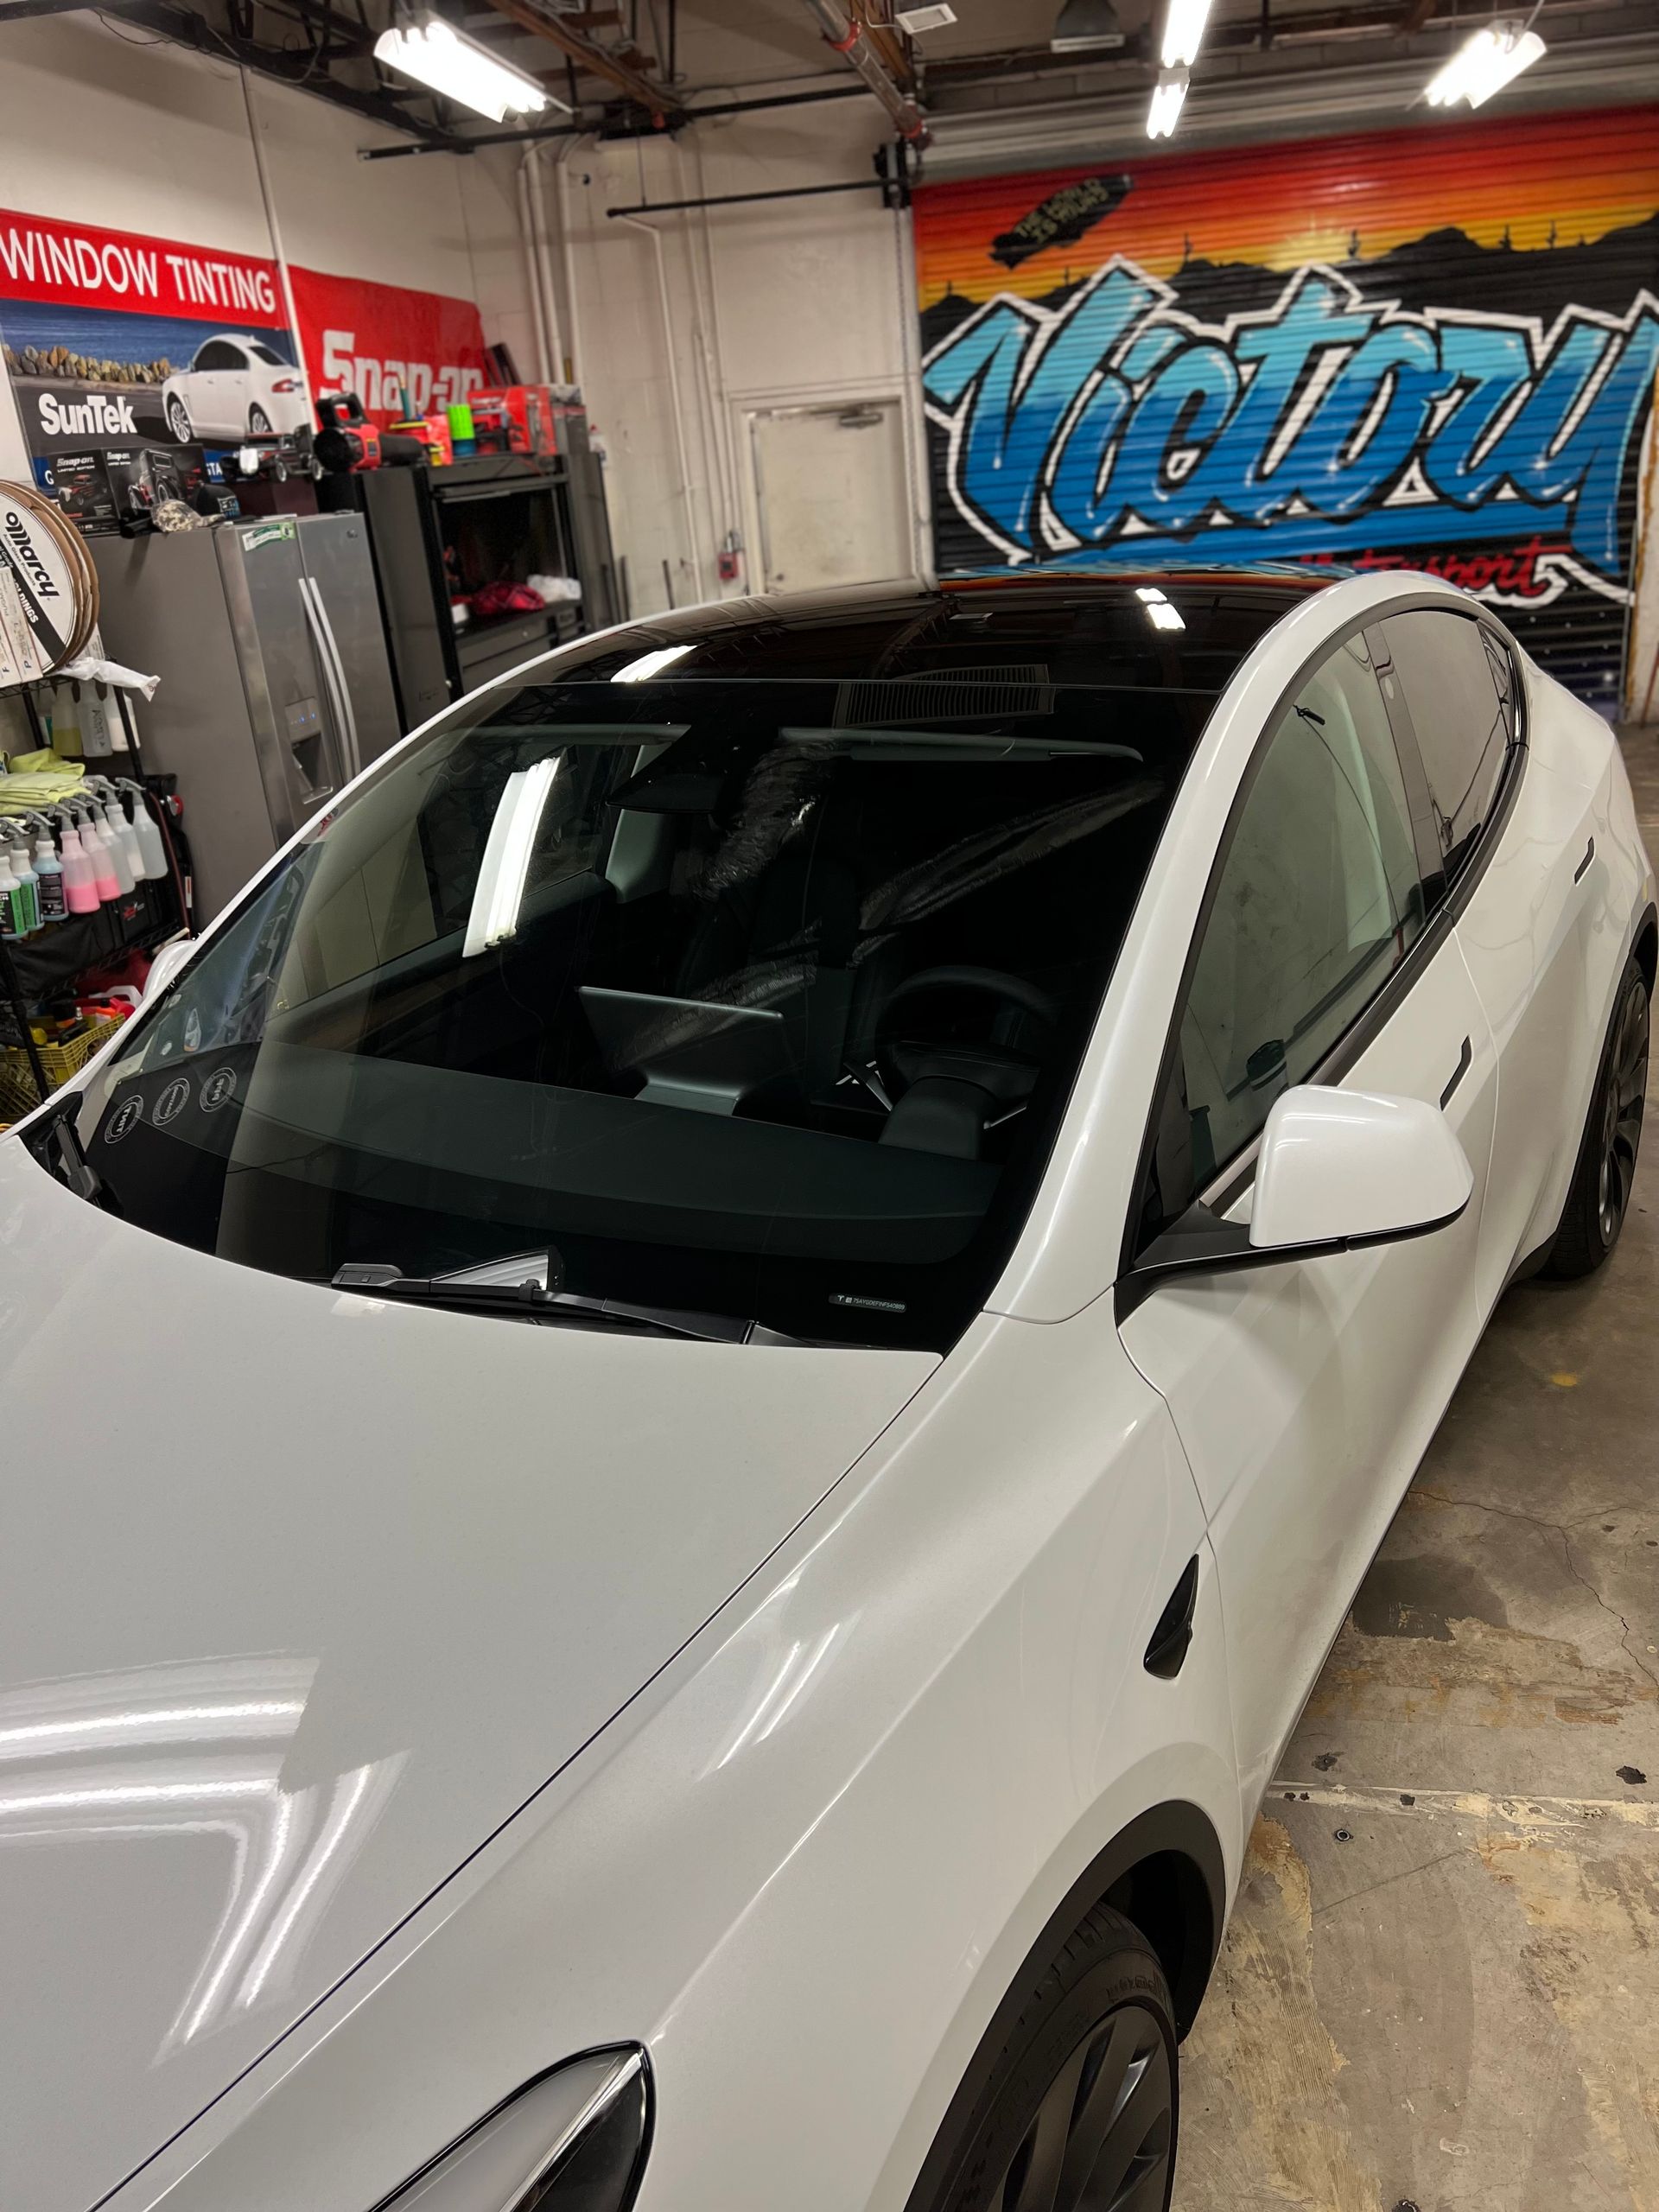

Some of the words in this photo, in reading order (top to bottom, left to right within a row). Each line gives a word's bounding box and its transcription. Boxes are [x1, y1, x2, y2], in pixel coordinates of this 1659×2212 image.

[0, 227, 158, 298] WINDOW
[165, 254, 276, 314] TINTING
[38, 393, 138, 435] SunTek
[56, 455, 95, 467] Snap-on
